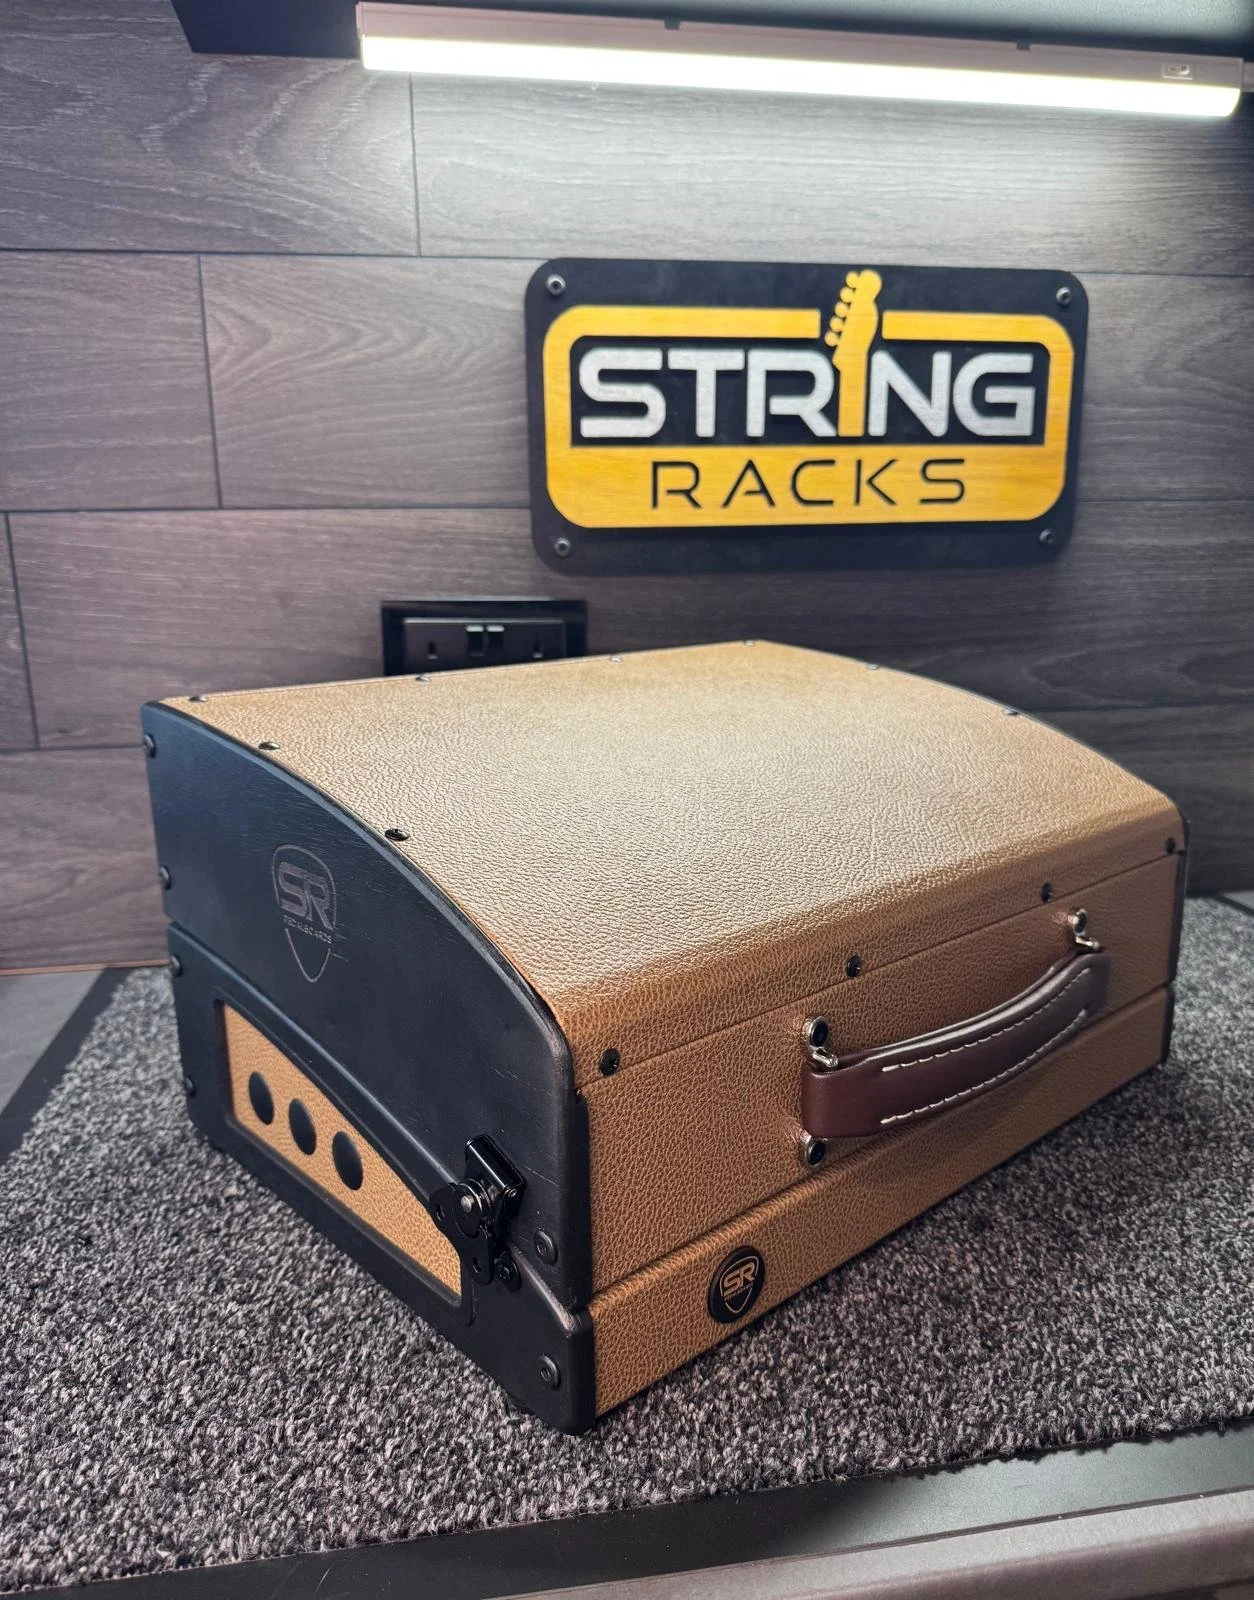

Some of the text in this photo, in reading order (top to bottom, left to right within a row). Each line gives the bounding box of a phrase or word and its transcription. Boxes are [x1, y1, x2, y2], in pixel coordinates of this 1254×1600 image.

[579, 347, 1035, 437] STRING
[651, 458, 966, 509] RACKS
[278, 861, 334, 931] SR
[723, 1262, 755, 1297] SR
